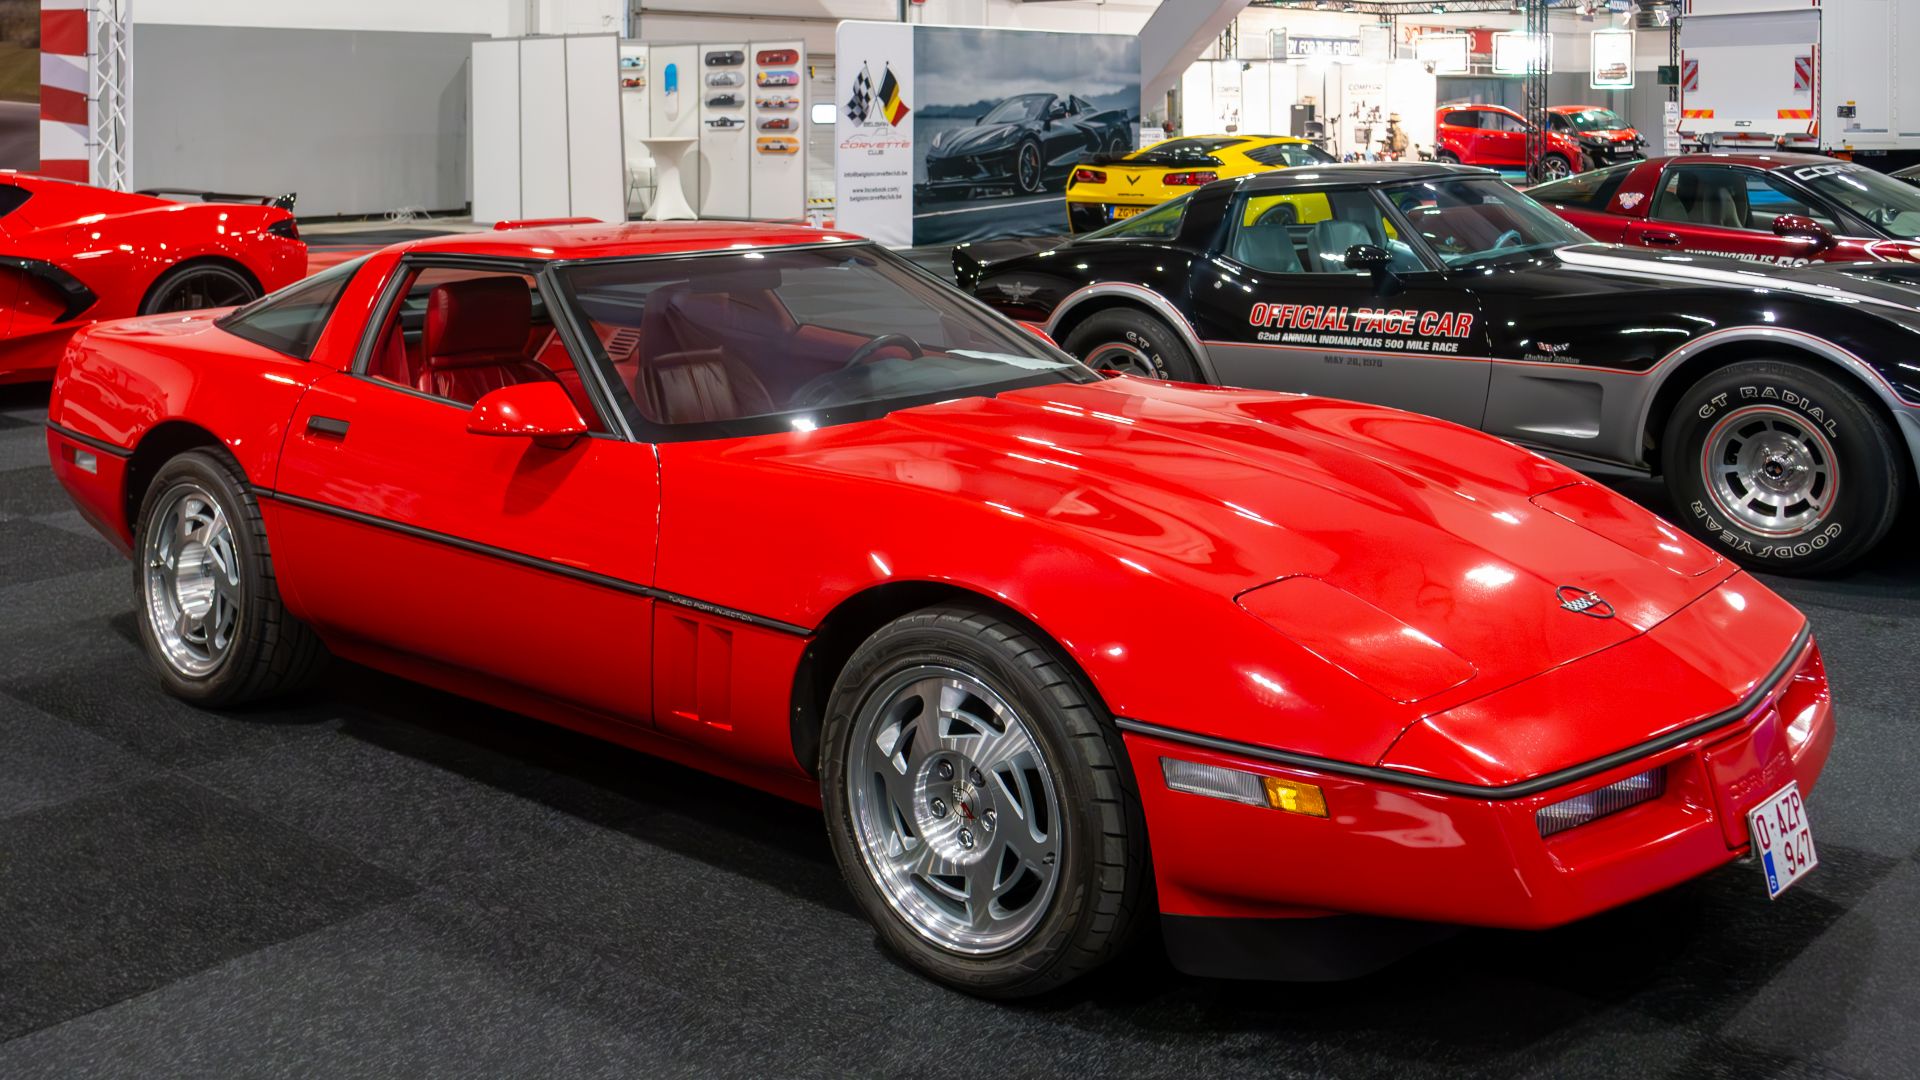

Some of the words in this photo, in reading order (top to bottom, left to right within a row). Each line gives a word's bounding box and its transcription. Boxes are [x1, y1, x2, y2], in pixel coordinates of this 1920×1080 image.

[1334, 41, 1360, 56] FUTUR
[840, 141, 912, 149] CORVETTE
[1249, 302, 1349, 332] OFFICIAL
[1353, 307, 1418, 335] PACE
[1419, 310, 1474, 338] CAR
[1257, 331, 1281, 342] 62nd
[1281, 332, 1318, 344] ANNUAL
[1319, 334, 1382, 348] INDIANAPOLIS
[1384, 338, 1404, 349] 500
[1406, 340, 1430, 351] MILE
[1432, 342, 1459, 353] RACE
[1698, 392, 1728, 420] GT
[1740, 386, 1837, 439] RADIAL
[1690, 500, 1843, 559] GOODYEAR
[668, 595, 693, 607] TUNED
[693, 601, 714, 612] PORT
[714, 607, 753, 622] INJECTION
[1784, 828, 1812, 876] 947
